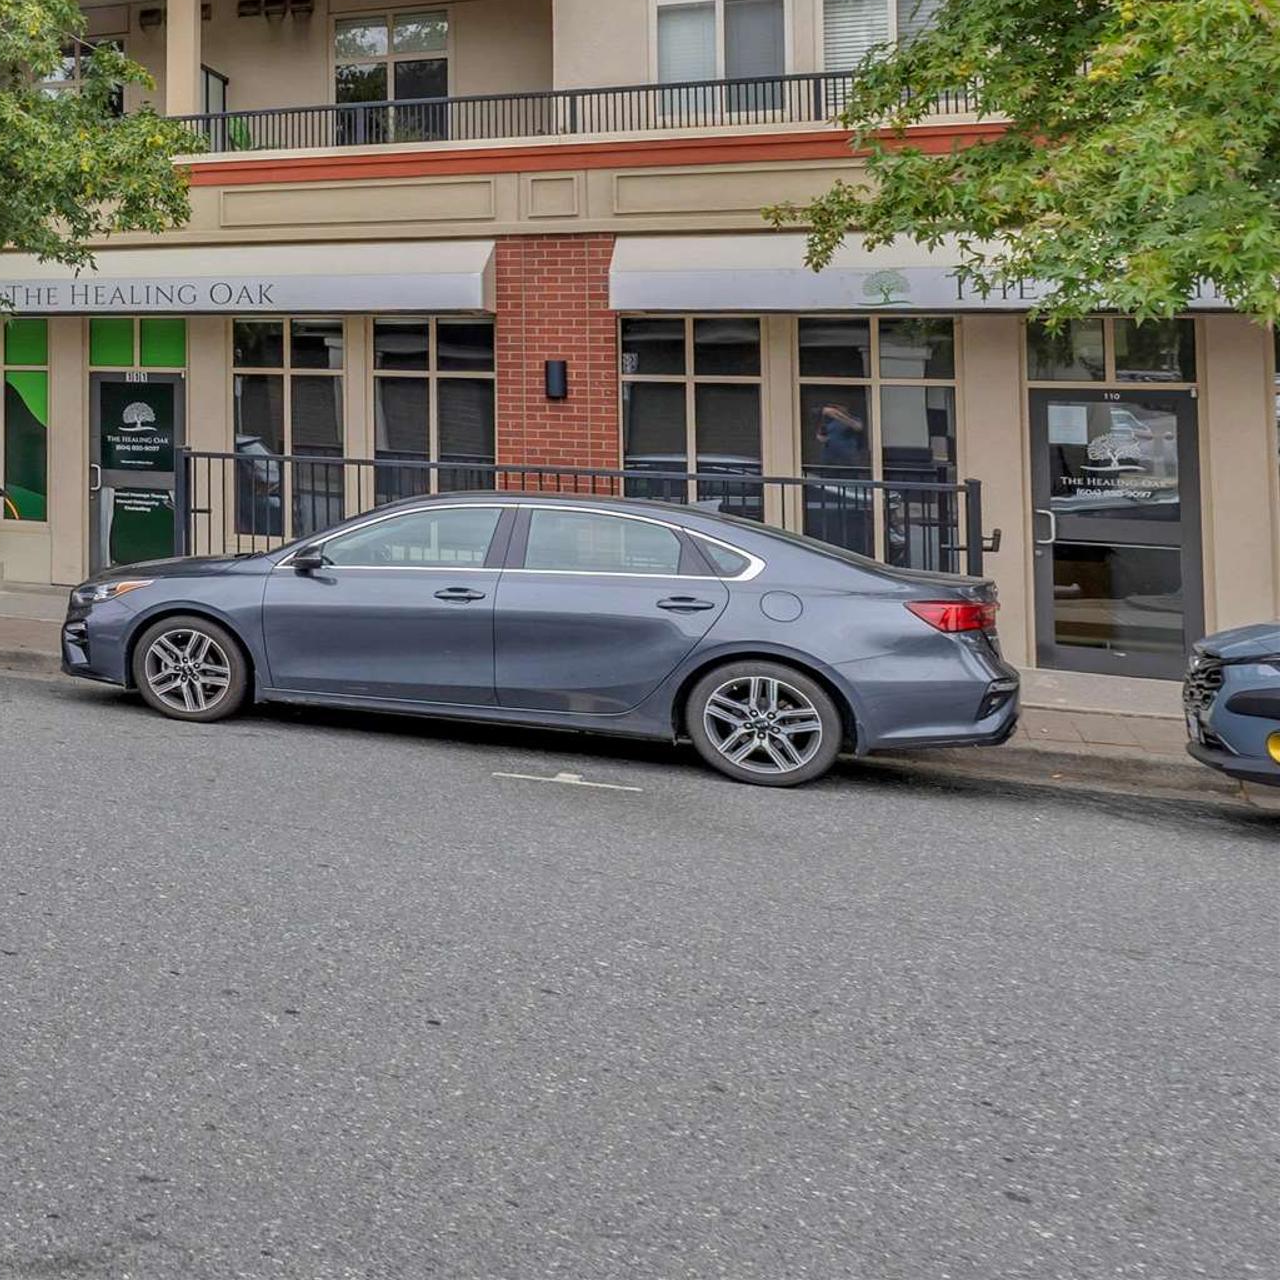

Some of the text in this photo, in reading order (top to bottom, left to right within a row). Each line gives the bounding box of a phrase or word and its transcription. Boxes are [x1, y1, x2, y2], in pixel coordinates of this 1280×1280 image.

[7, 282, 274, 305] THE HEALING OAK
[1104, 392, 1120, 400] 110
[1060, 476, 1084, 485] THE
[1087, 477, 1139, 487] HEALING
